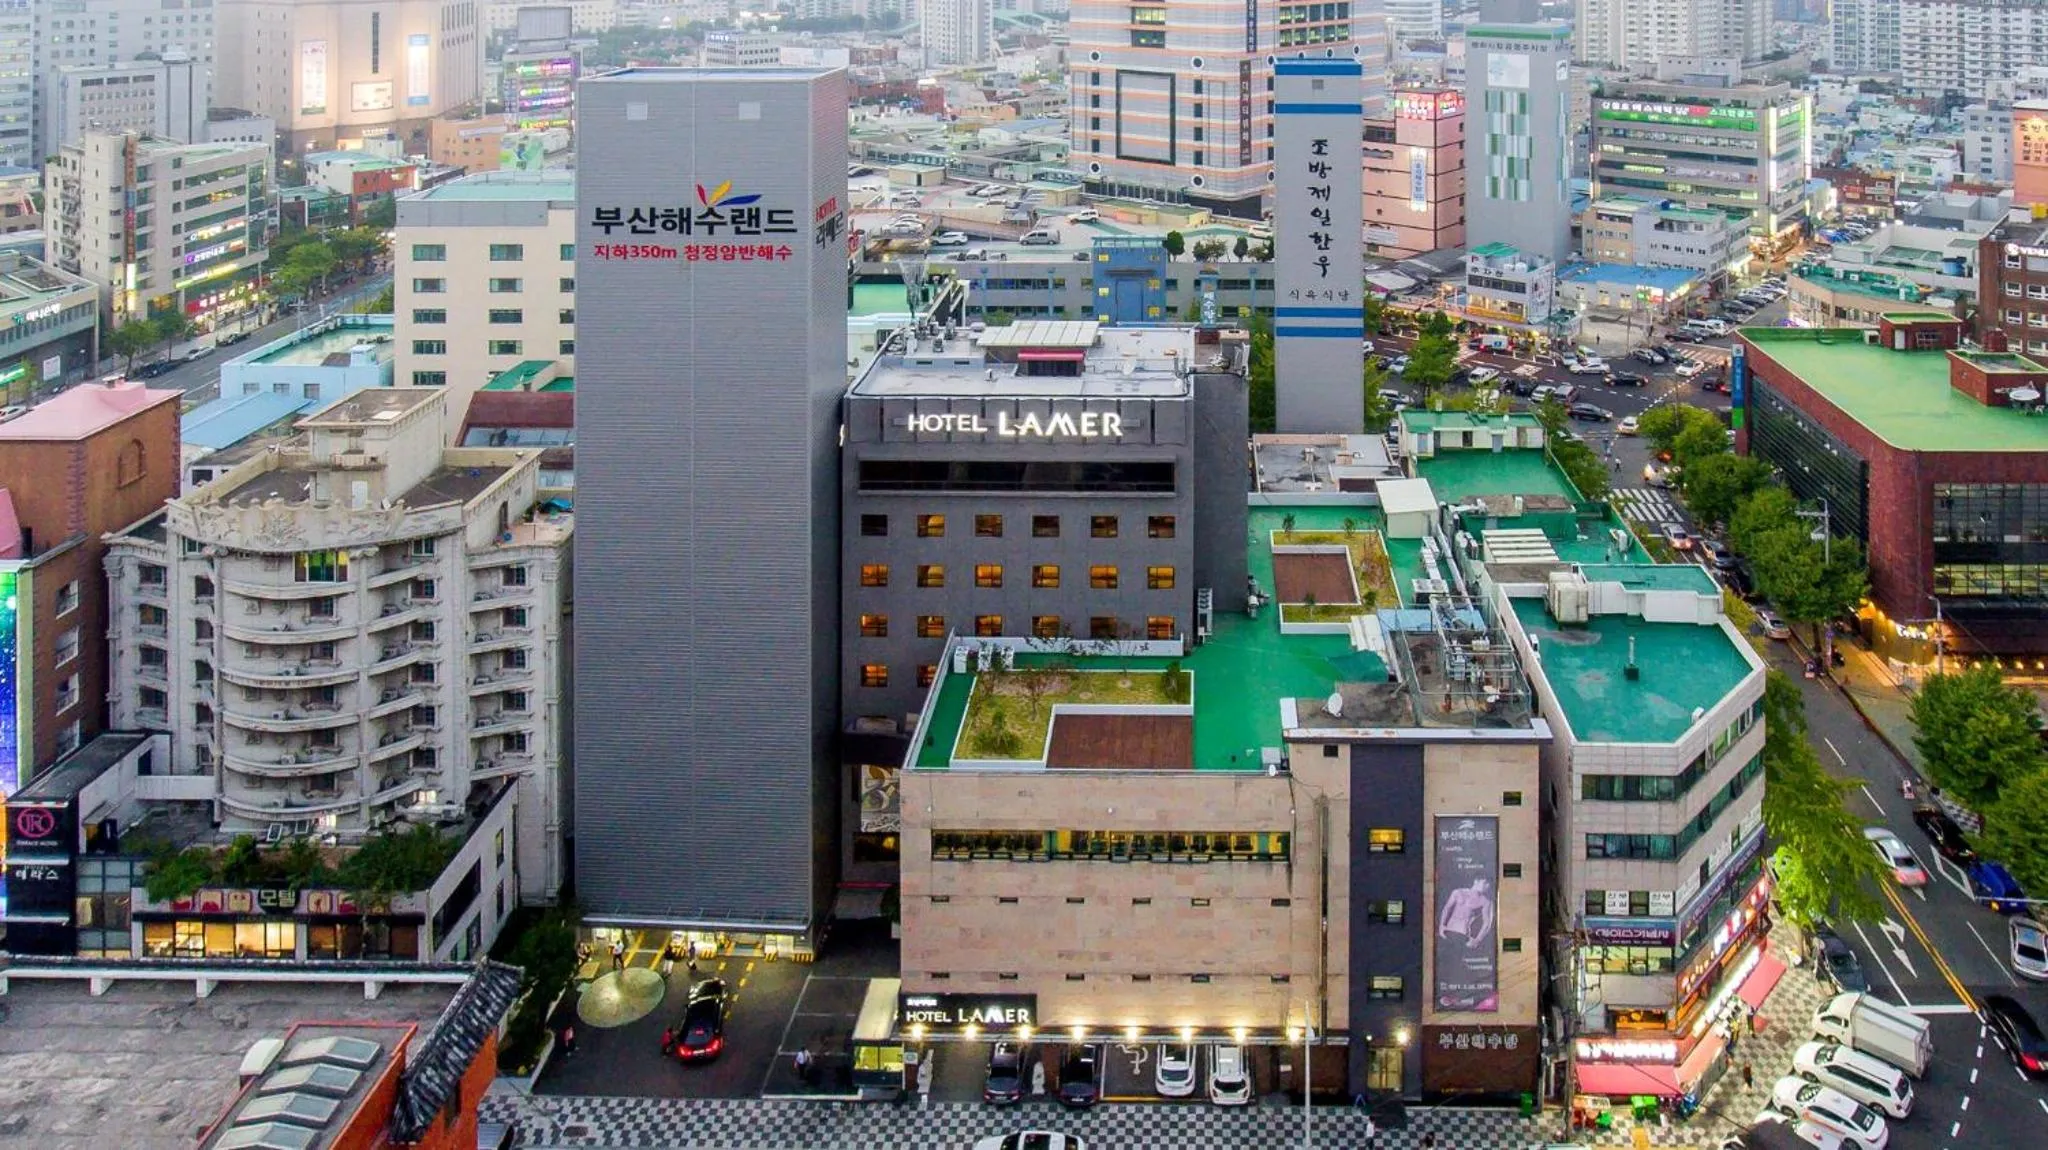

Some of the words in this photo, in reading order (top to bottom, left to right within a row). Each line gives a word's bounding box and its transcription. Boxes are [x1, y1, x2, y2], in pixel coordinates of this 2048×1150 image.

[1306, 138, 1334, 278] 조방제일한우
[591, 206, 798, 236] 부산해수랜드
[594, 244, 677, 261] 지하350m
[684, 244, 793, 261] 청정암반해수
[1288, 288, 1350, 301] 식육식당
[907, 413, 988, 433] HOTEL
[998, 411, 1124, 437] LAMER
[260, 889, 296, 908] 모텔
[905, 1010, 953, 1023] HOTEL
[958, 1006, 1030, 1024] LAMER
